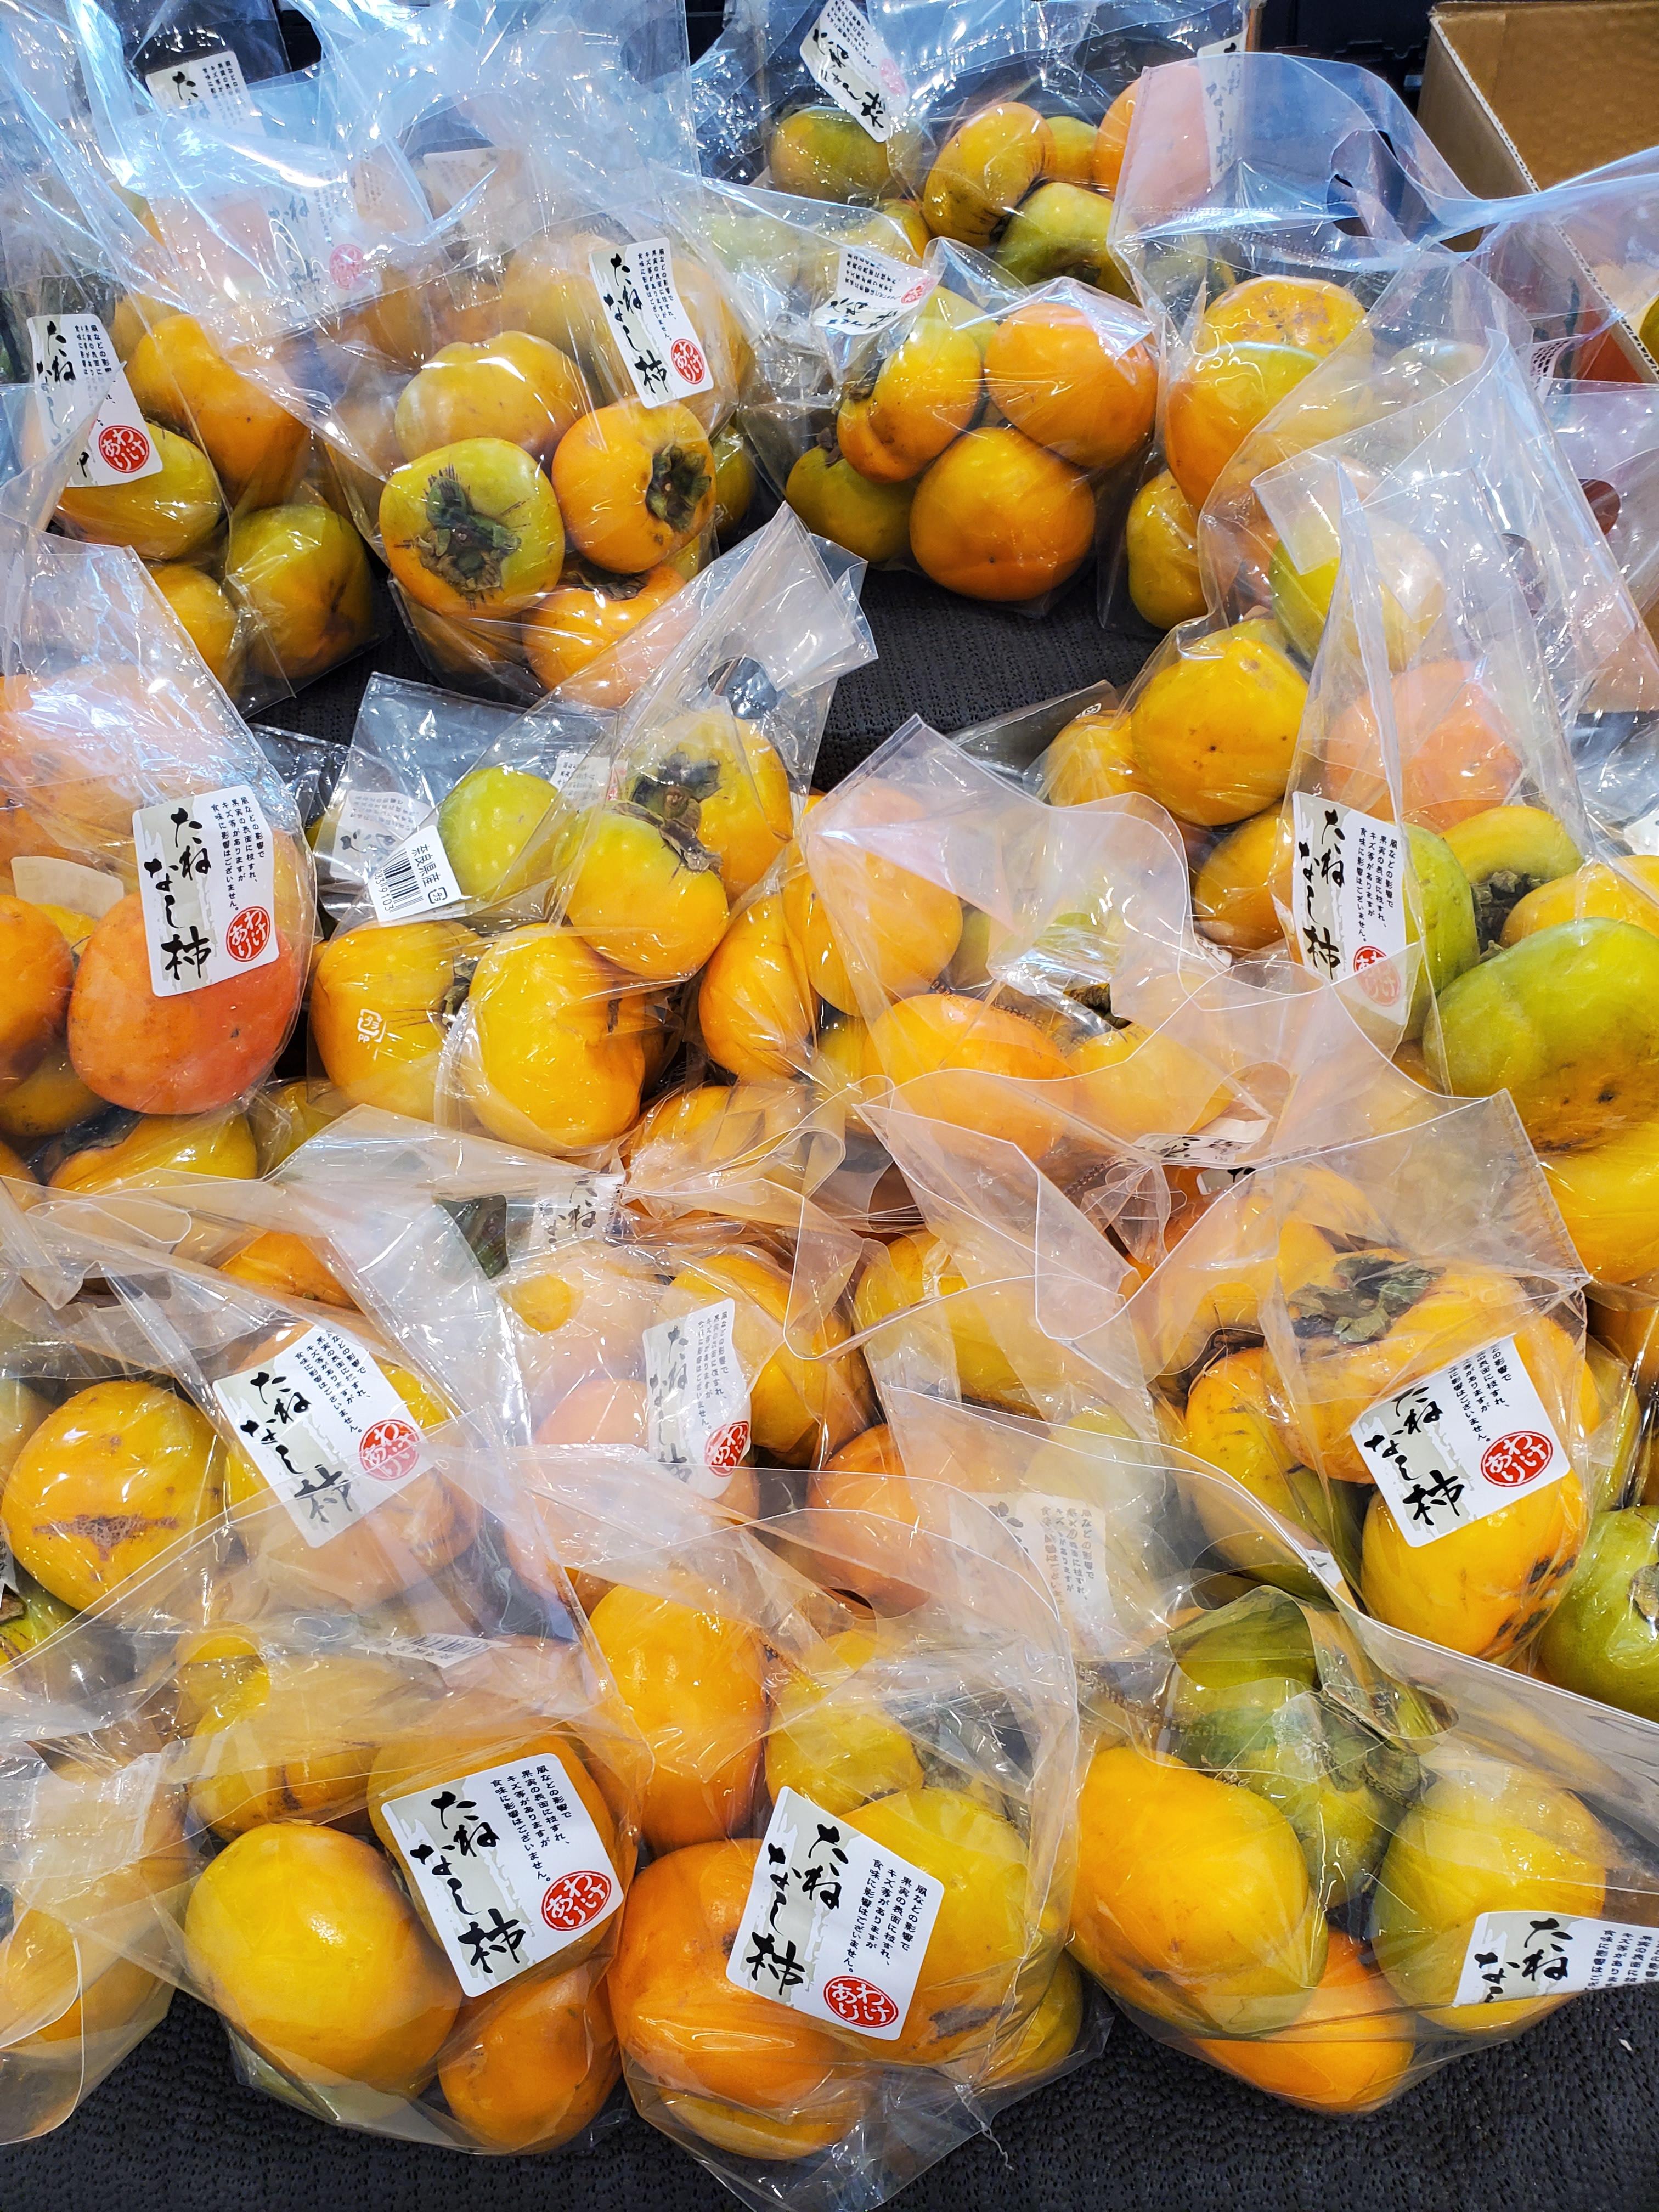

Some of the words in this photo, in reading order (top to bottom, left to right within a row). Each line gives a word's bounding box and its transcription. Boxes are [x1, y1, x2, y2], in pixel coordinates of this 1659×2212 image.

[211, 805, 239, 911] 食味に影響はございません。
[222, 803, 246, 882] キズ等がありますが
[232, 800, 258, 882] 果実の表面に枝すれ、
[241, 797, 265, 858] 風などの影響で
[379, 888, 394, 911] 9103
[411, 844, 441, 887] 奈良県産
[1386, 839, 1398, 909] 風などの影響で
[507, 1775, 551, 1847] キズ等がありますが
[521, 1770, 570, 1844] 果実の表面に枝すれ、
[536, 1765, 572, 1818] 風などの影響で
[490, 1779, 551, 1882] 食味に影響はございません。
[843, 1859, 884, 1973] 食味に影響はございません。
[865, 1868, 897, 1949] キズ等がありますが
[879, 1876, 913, 1966] 果実の表面に枝すれ、
[900, 1884, 927, 1951] 風などの影響で
